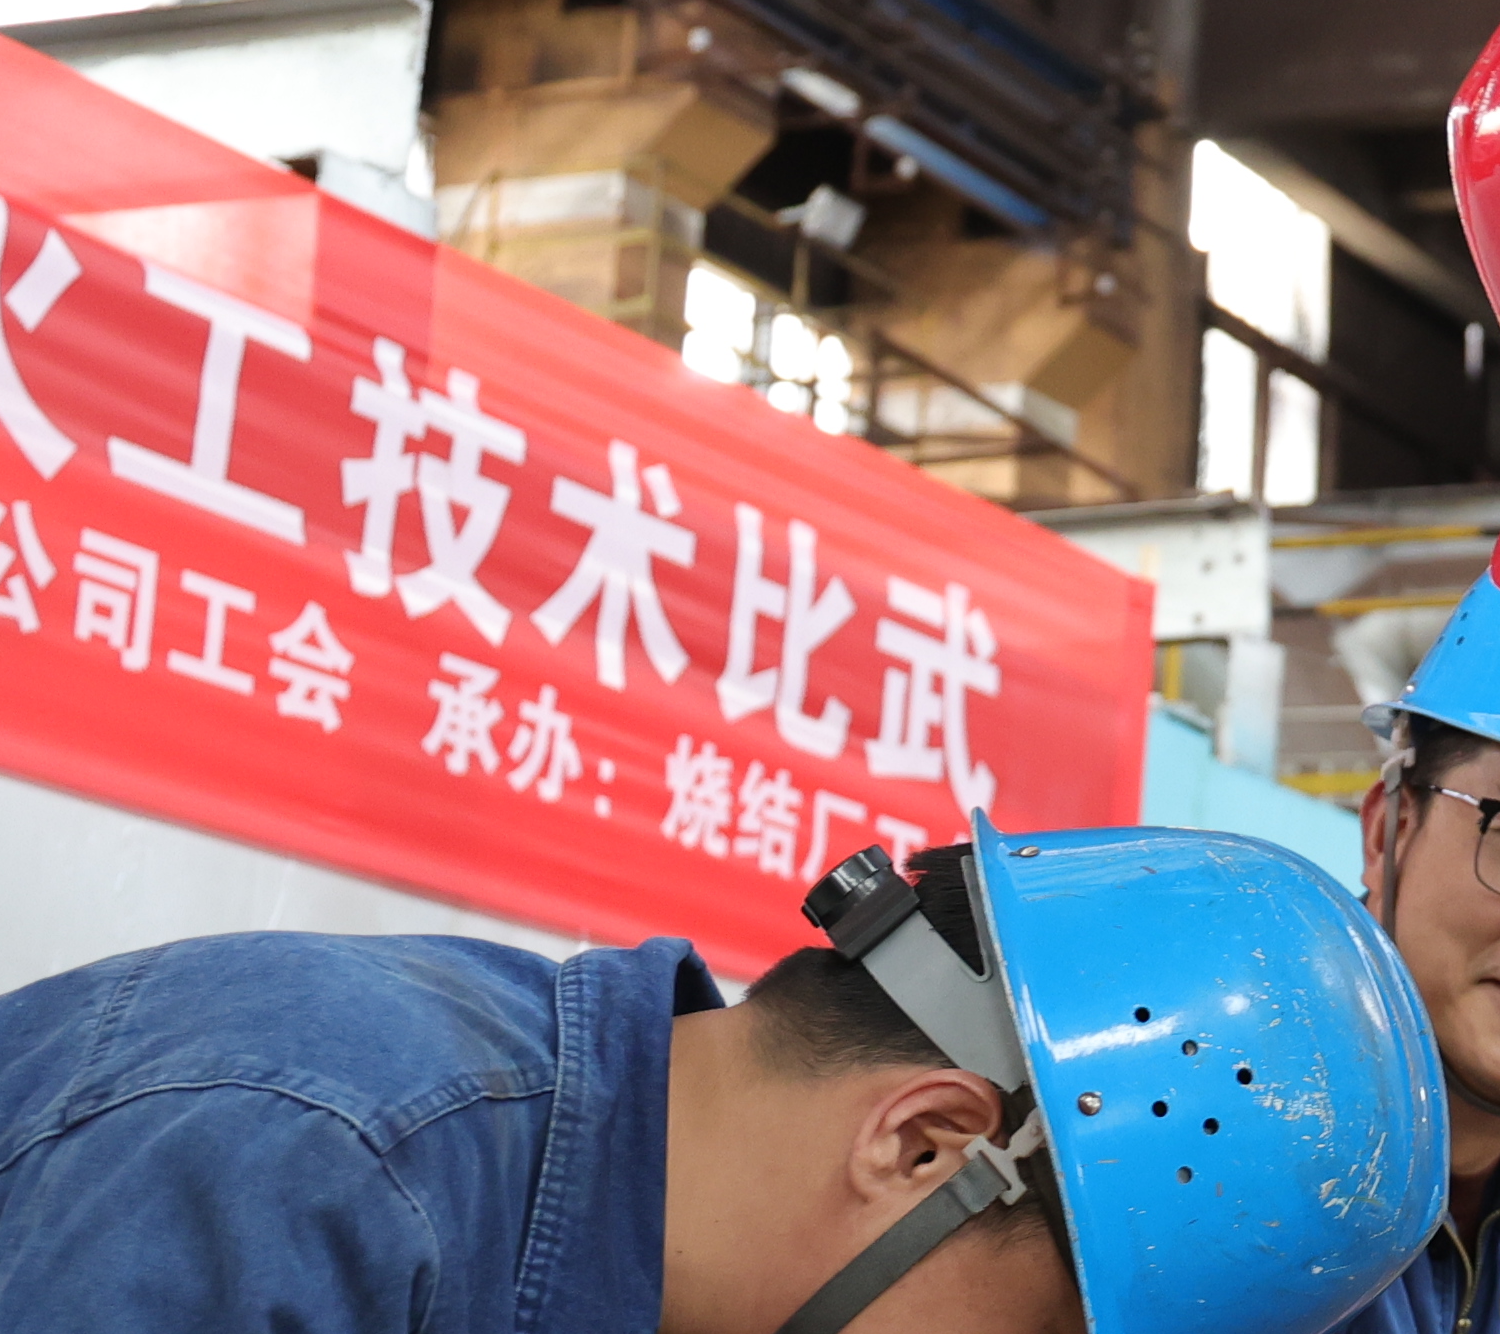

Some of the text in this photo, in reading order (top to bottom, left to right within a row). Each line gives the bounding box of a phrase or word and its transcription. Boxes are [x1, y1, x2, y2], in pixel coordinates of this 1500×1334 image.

[421, 652, 978, 886] 承办：烧结厂工
